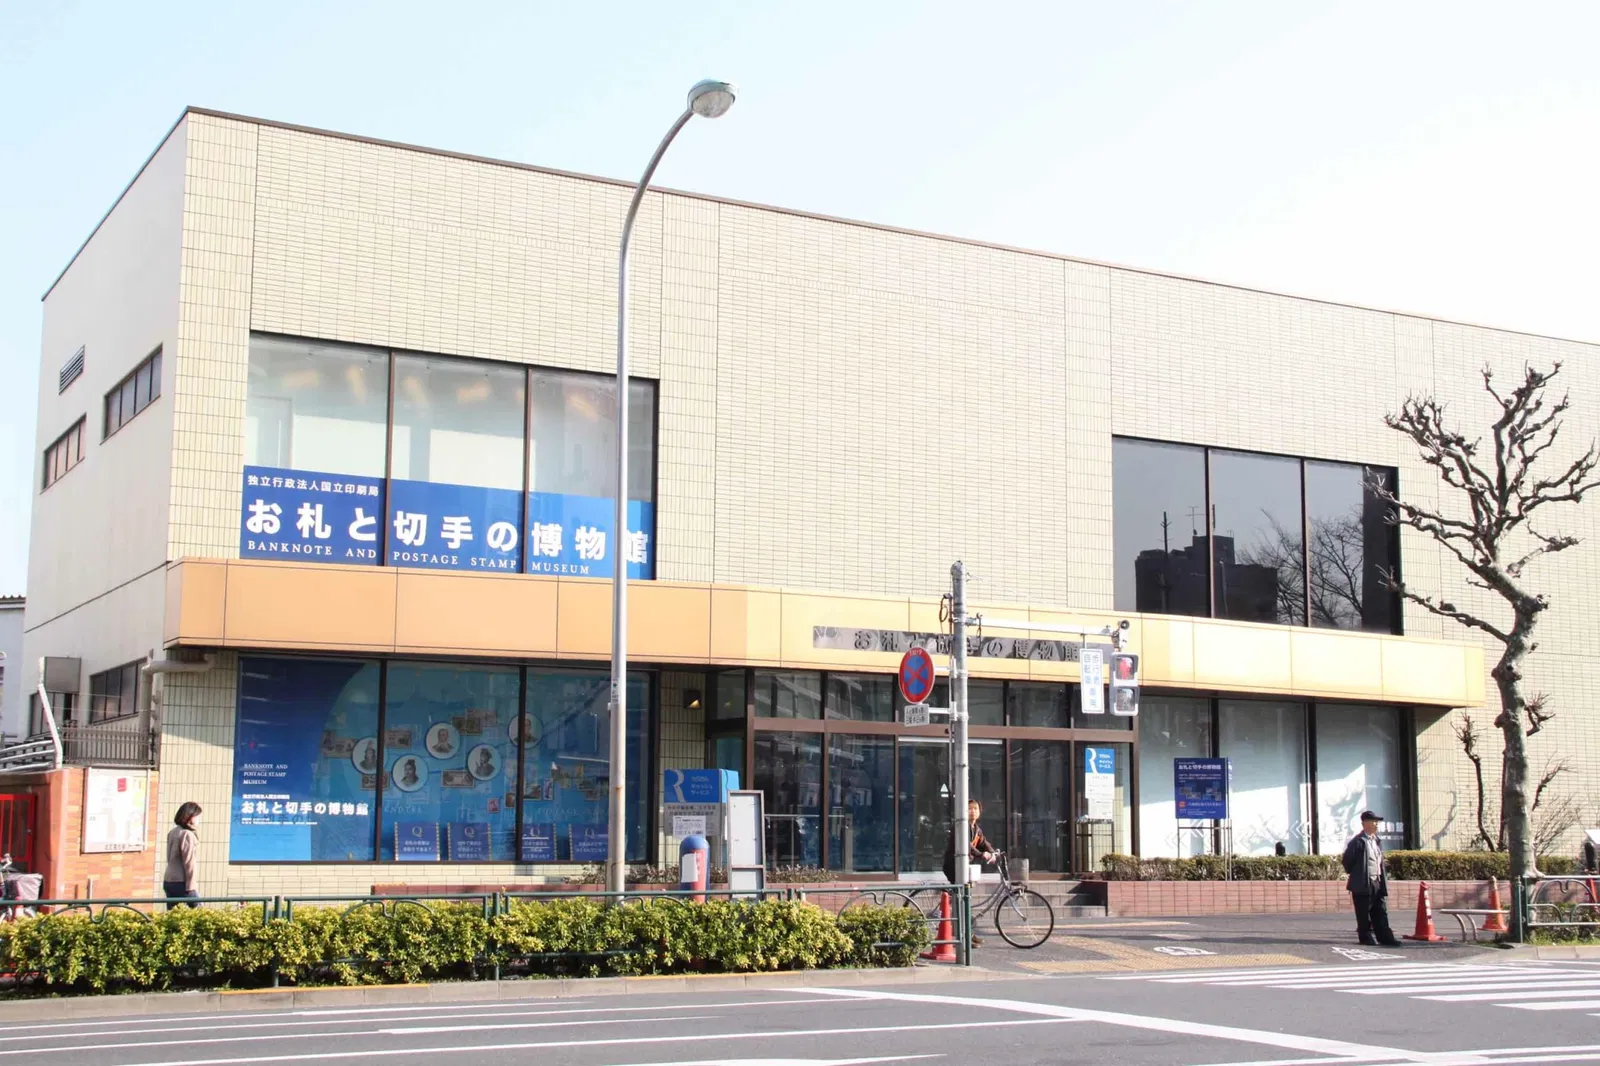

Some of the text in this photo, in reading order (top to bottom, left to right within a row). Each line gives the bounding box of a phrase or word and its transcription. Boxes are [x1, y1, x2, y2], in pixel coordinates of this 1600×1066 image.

[247, 475, 379, 497] 独立行政法人国立印刷局
[248, 540, 590, 574] BANKNOTE AND POSTAGE STAMP MUSEUM
[241, 800, 369, 816] お札と切手の博物館
[411, 826, 423, 838] Q
